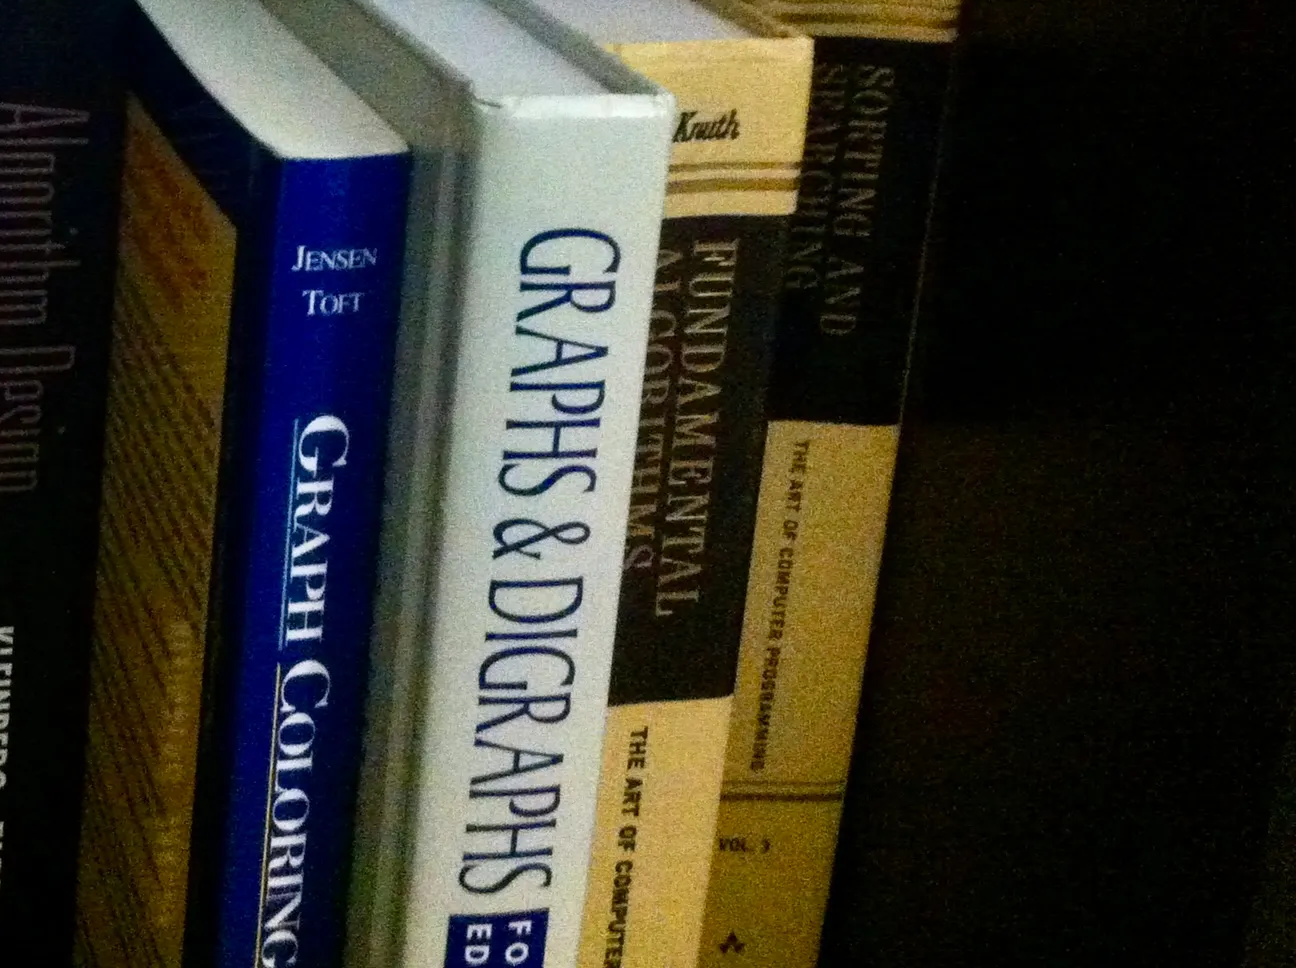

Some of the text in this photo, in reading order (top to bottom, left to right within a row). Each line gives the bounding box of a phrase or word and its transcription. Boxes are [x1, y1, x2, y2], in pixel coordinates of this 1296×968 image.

[673, 109, 740, 142] Knuth
[291, 244, 379, 272] JENSEN
[301, 289, 366, 316] TOFT
[818, 254, 864, 337] AND
[653, 238, 739, 617] FUNDAMENTAL
[789, 440, 810, 473] THE
[784, 480, 802, 512] ART
[282, 414, 349, 644] GRAPH
[781, 519, 797, 540] OF
[456, 229, 620, 895] GRAPHS & DIGRAPHS
[766, 547, 793, 641] COMPUTER
[626, 726, 648, 770] THE
[620, 778, 642, 817] ART
[617, 826, 637, 852] OF
